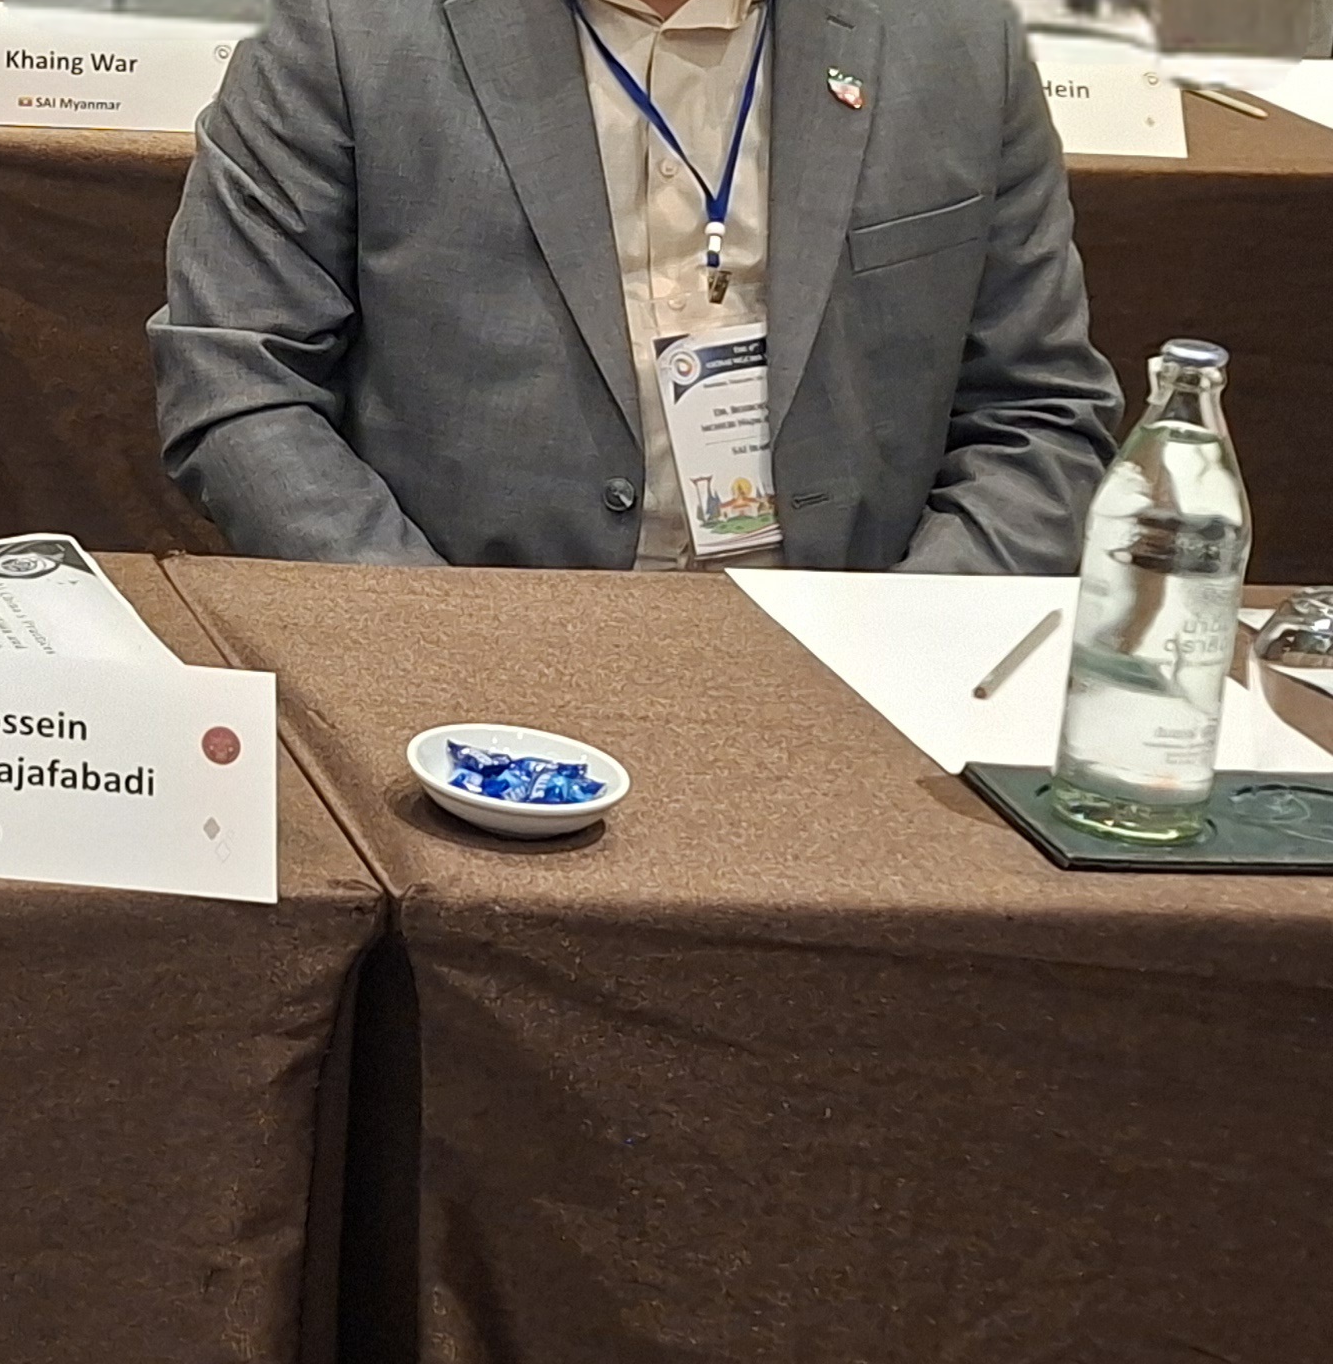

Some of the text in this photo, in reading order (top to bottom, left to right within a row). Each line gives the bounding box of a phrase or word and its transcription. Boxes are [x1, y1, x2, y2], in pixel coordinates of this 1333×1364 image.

[6, 49, 138, 76] Khaing War
[35, 96, 122, 112] SAI Myanmar
